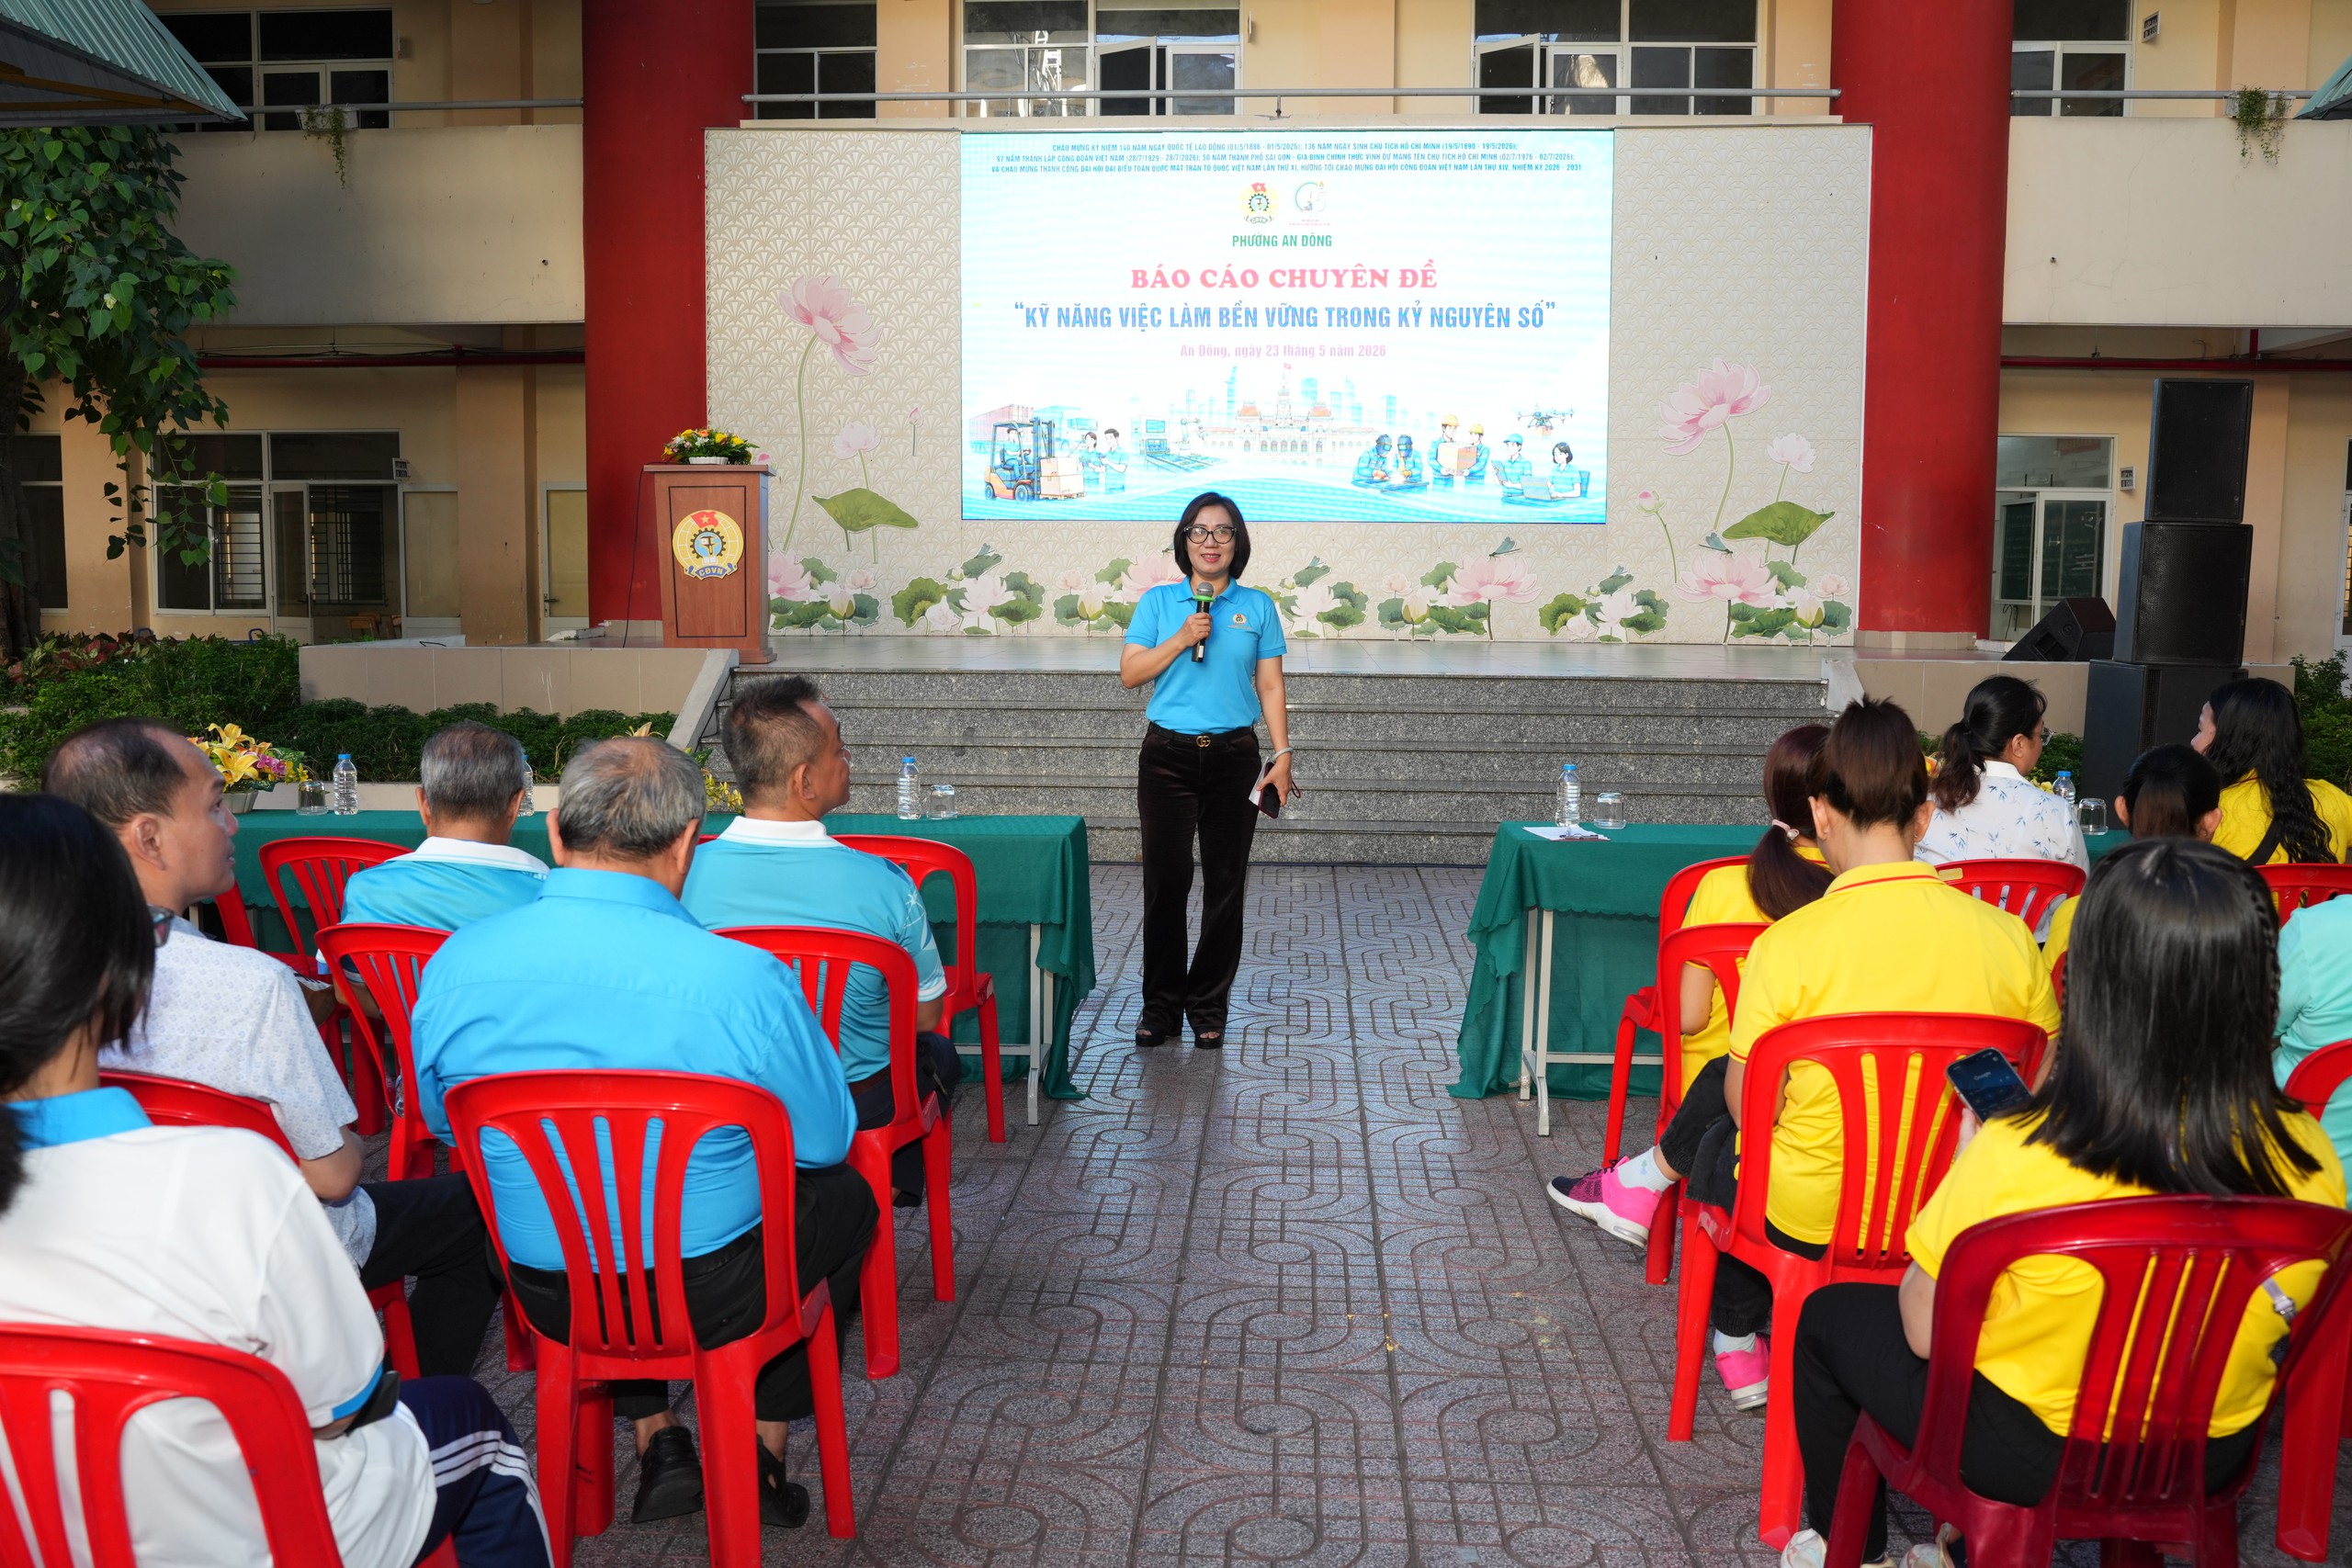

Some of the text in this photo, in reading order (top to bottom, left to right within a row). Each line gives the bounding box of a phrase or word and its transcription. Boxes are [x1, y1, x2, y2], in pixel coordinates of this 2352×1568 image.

[1232, 232, 1332, 247] PHƯỜNG AN ĐÔNG
[1130, 259, 1437, 288] BÁO CÁO CHUYÊN ĐỀ
[1014, 299, 1556, 333] “KỸ NĂNG VIỆC LÀM BỀN VỮNG TRONG KỶ NGUYÊN SỐ”
[1181, 344, 1386, 359] An Đông, ngày 23 tháng 5 năm 2026
[698, 567, 723, 576] CĐVN
